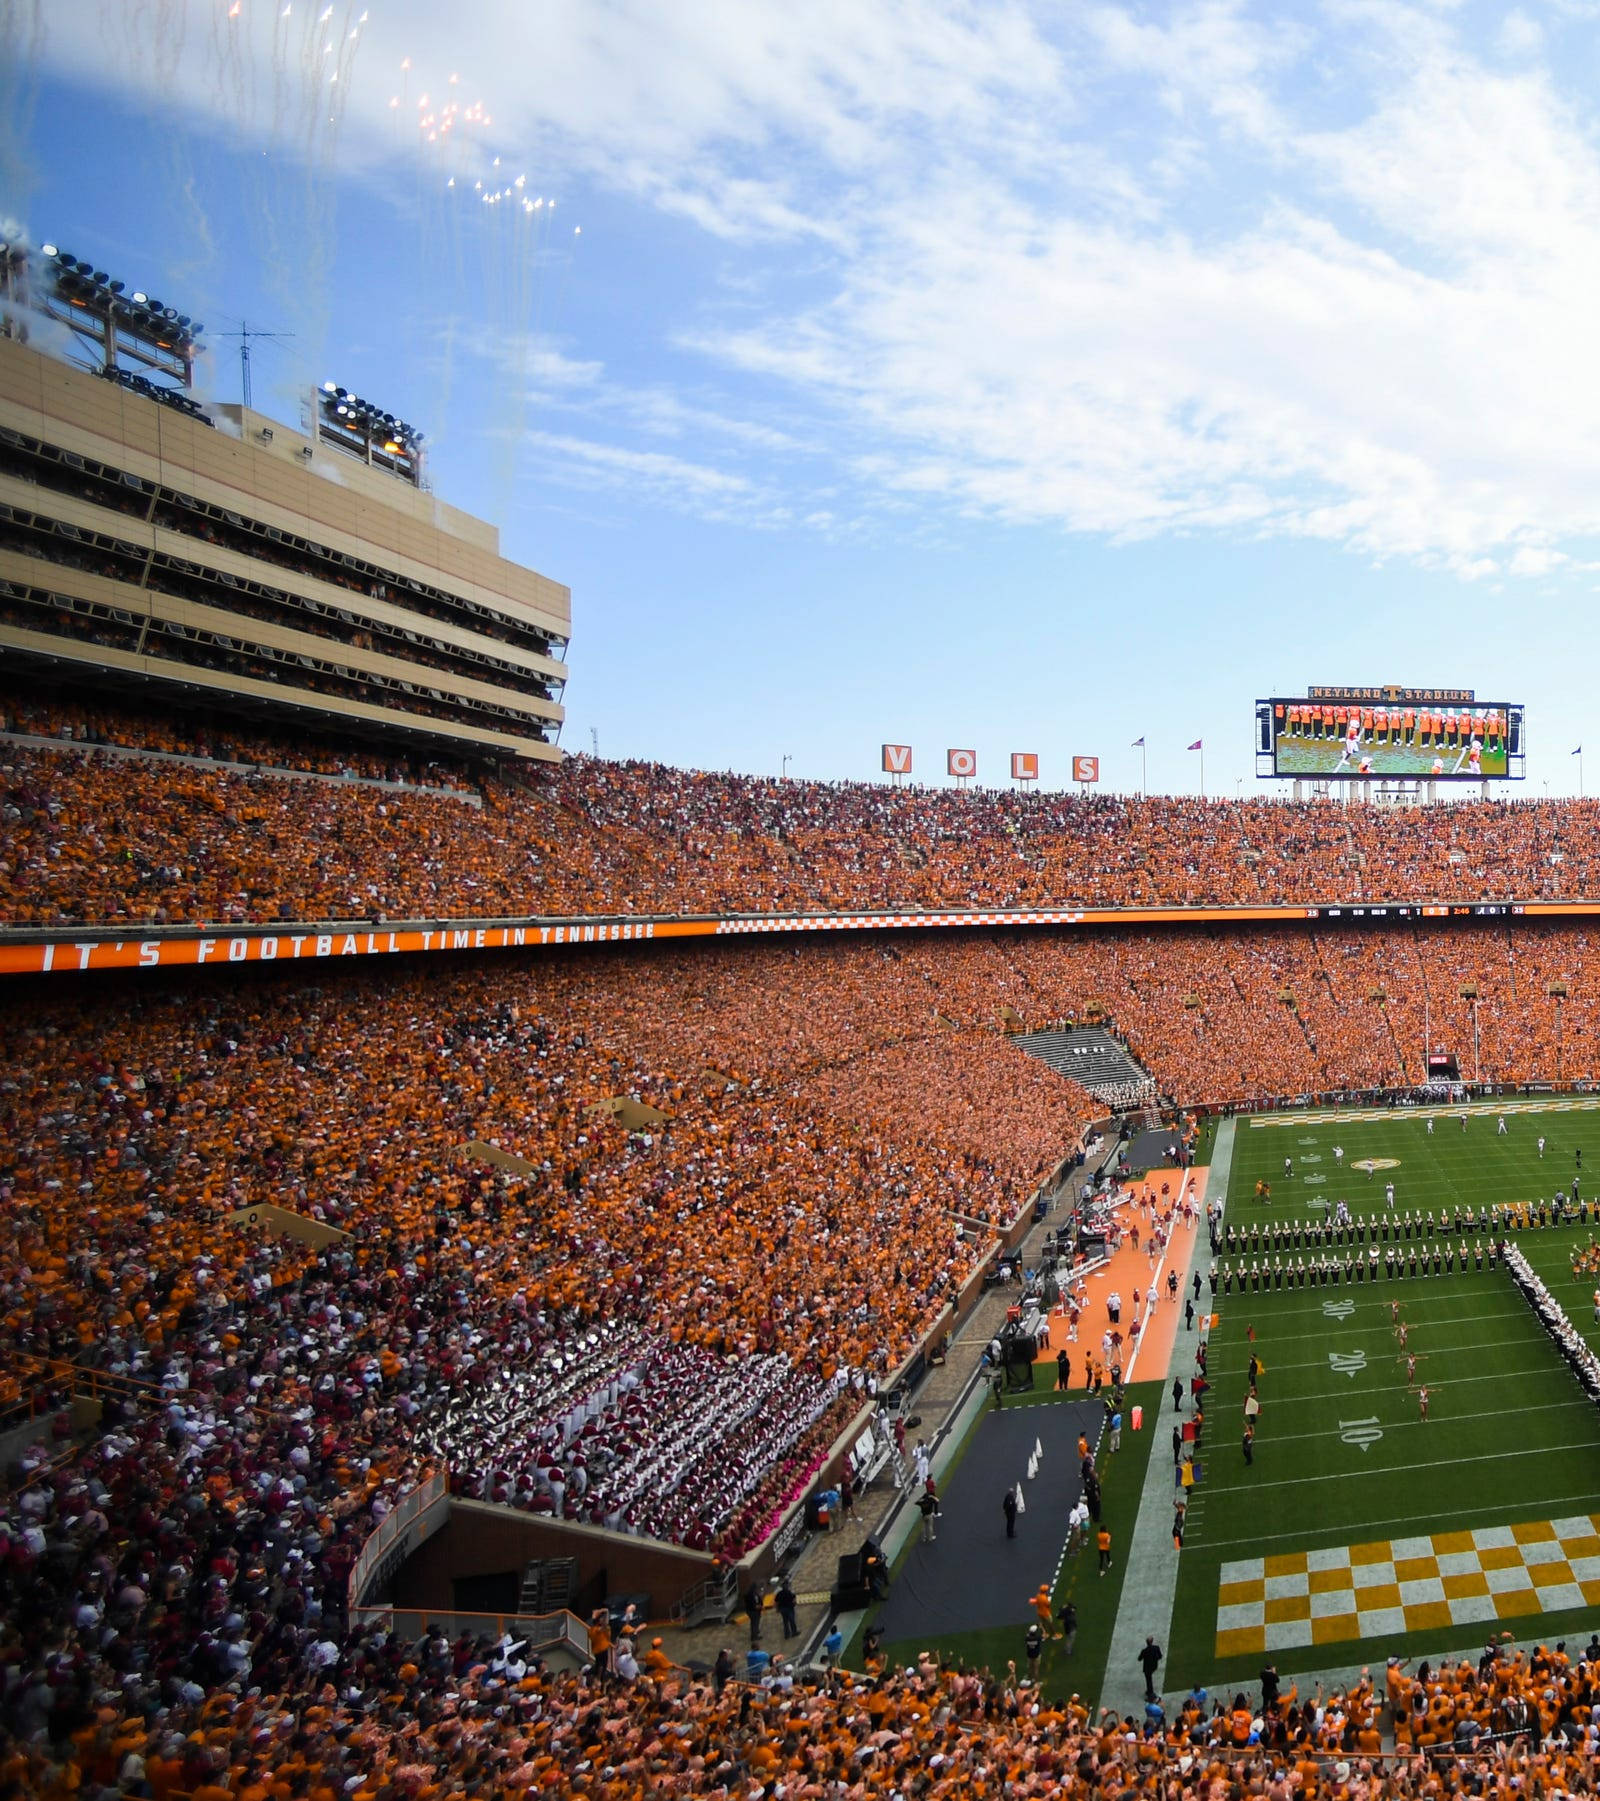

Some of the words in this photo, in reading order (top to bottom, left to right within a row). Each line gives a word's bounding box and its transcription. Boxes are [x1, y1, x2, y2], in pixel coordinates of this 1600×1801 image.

[1313, 686, 1381, 699] NEYLAND
[1383, 684, 1402, 702] T
[1404, 689, 1471, 701] STADIUM
[42, 941, 162, 971] IT'S
[197, 931, 401, 964] FOOTBALL
[421, 929, 486, 951] TIME
[502, 928, 527, 946] IN
[539, 922, 656, 945] TENNESSEE
[1339, 1415, 1384, 1444] 10
